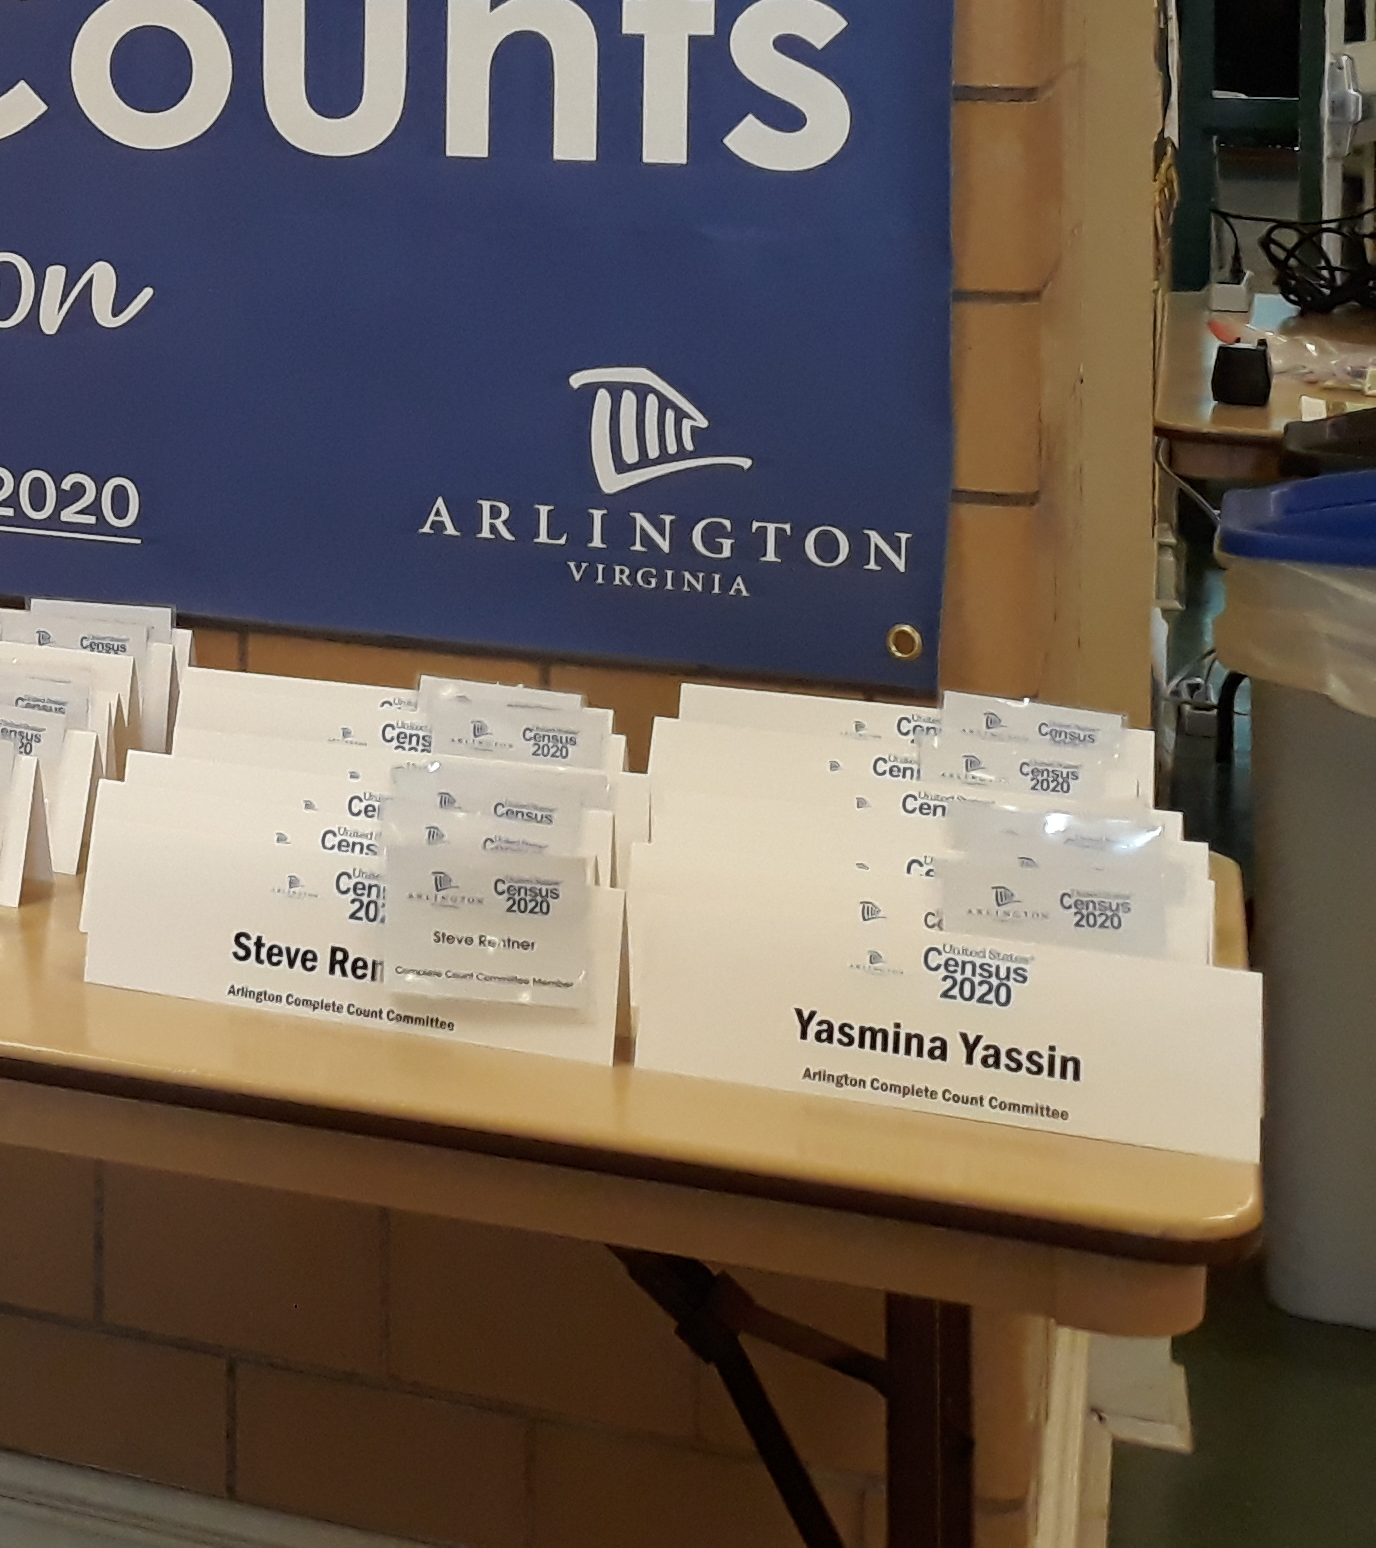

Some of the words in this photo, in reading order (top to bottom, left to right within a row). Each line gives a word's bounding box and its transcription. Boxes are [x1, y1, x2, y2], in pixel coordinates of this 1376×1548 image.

[419, 495, 912, 573] ARLINGTON
[566, 561, 752, 597] VIRGINIA
[523, 727, 577, 746] Census
[1038, 722, 1096, 744] Census
[532, 743, 569, 759] 2020
[1019, 762, 1079, 781] Census
[1030, 777, 1071, 794] 2020
[494, 802, 554, 825] Census
[494, 878, 560, 900] Census
[506, 898, 550, 915] 2020
[1059, 892, 1132, 914] Census
[1073, 911, 1122, 930] 2020
[432, 931, 474, 947] Steve
[232, 932, 318, 972] Steve
[328, 945, 384, 983] Ren
[923, 947, 1028, 984] Census
[940, 975, 1012, 1007] 2020
[227, 984, 282, 1004] Arlington
[286, 993, 344, 1014] Complete
[346, 1004, 384, 1020] Count
[386, 1008, 455, 1031] Committee
[794, 1007, 948, 1062] Yasmina
[958, 1031, 1082, 1082] Yassin
[802, 1067, 866, 1089] Arlington
[870, 1077, 938, 1100] Complete
[941, 1089, 984, 1108] Count
[988, 1096, 1069, 1121] Committee
